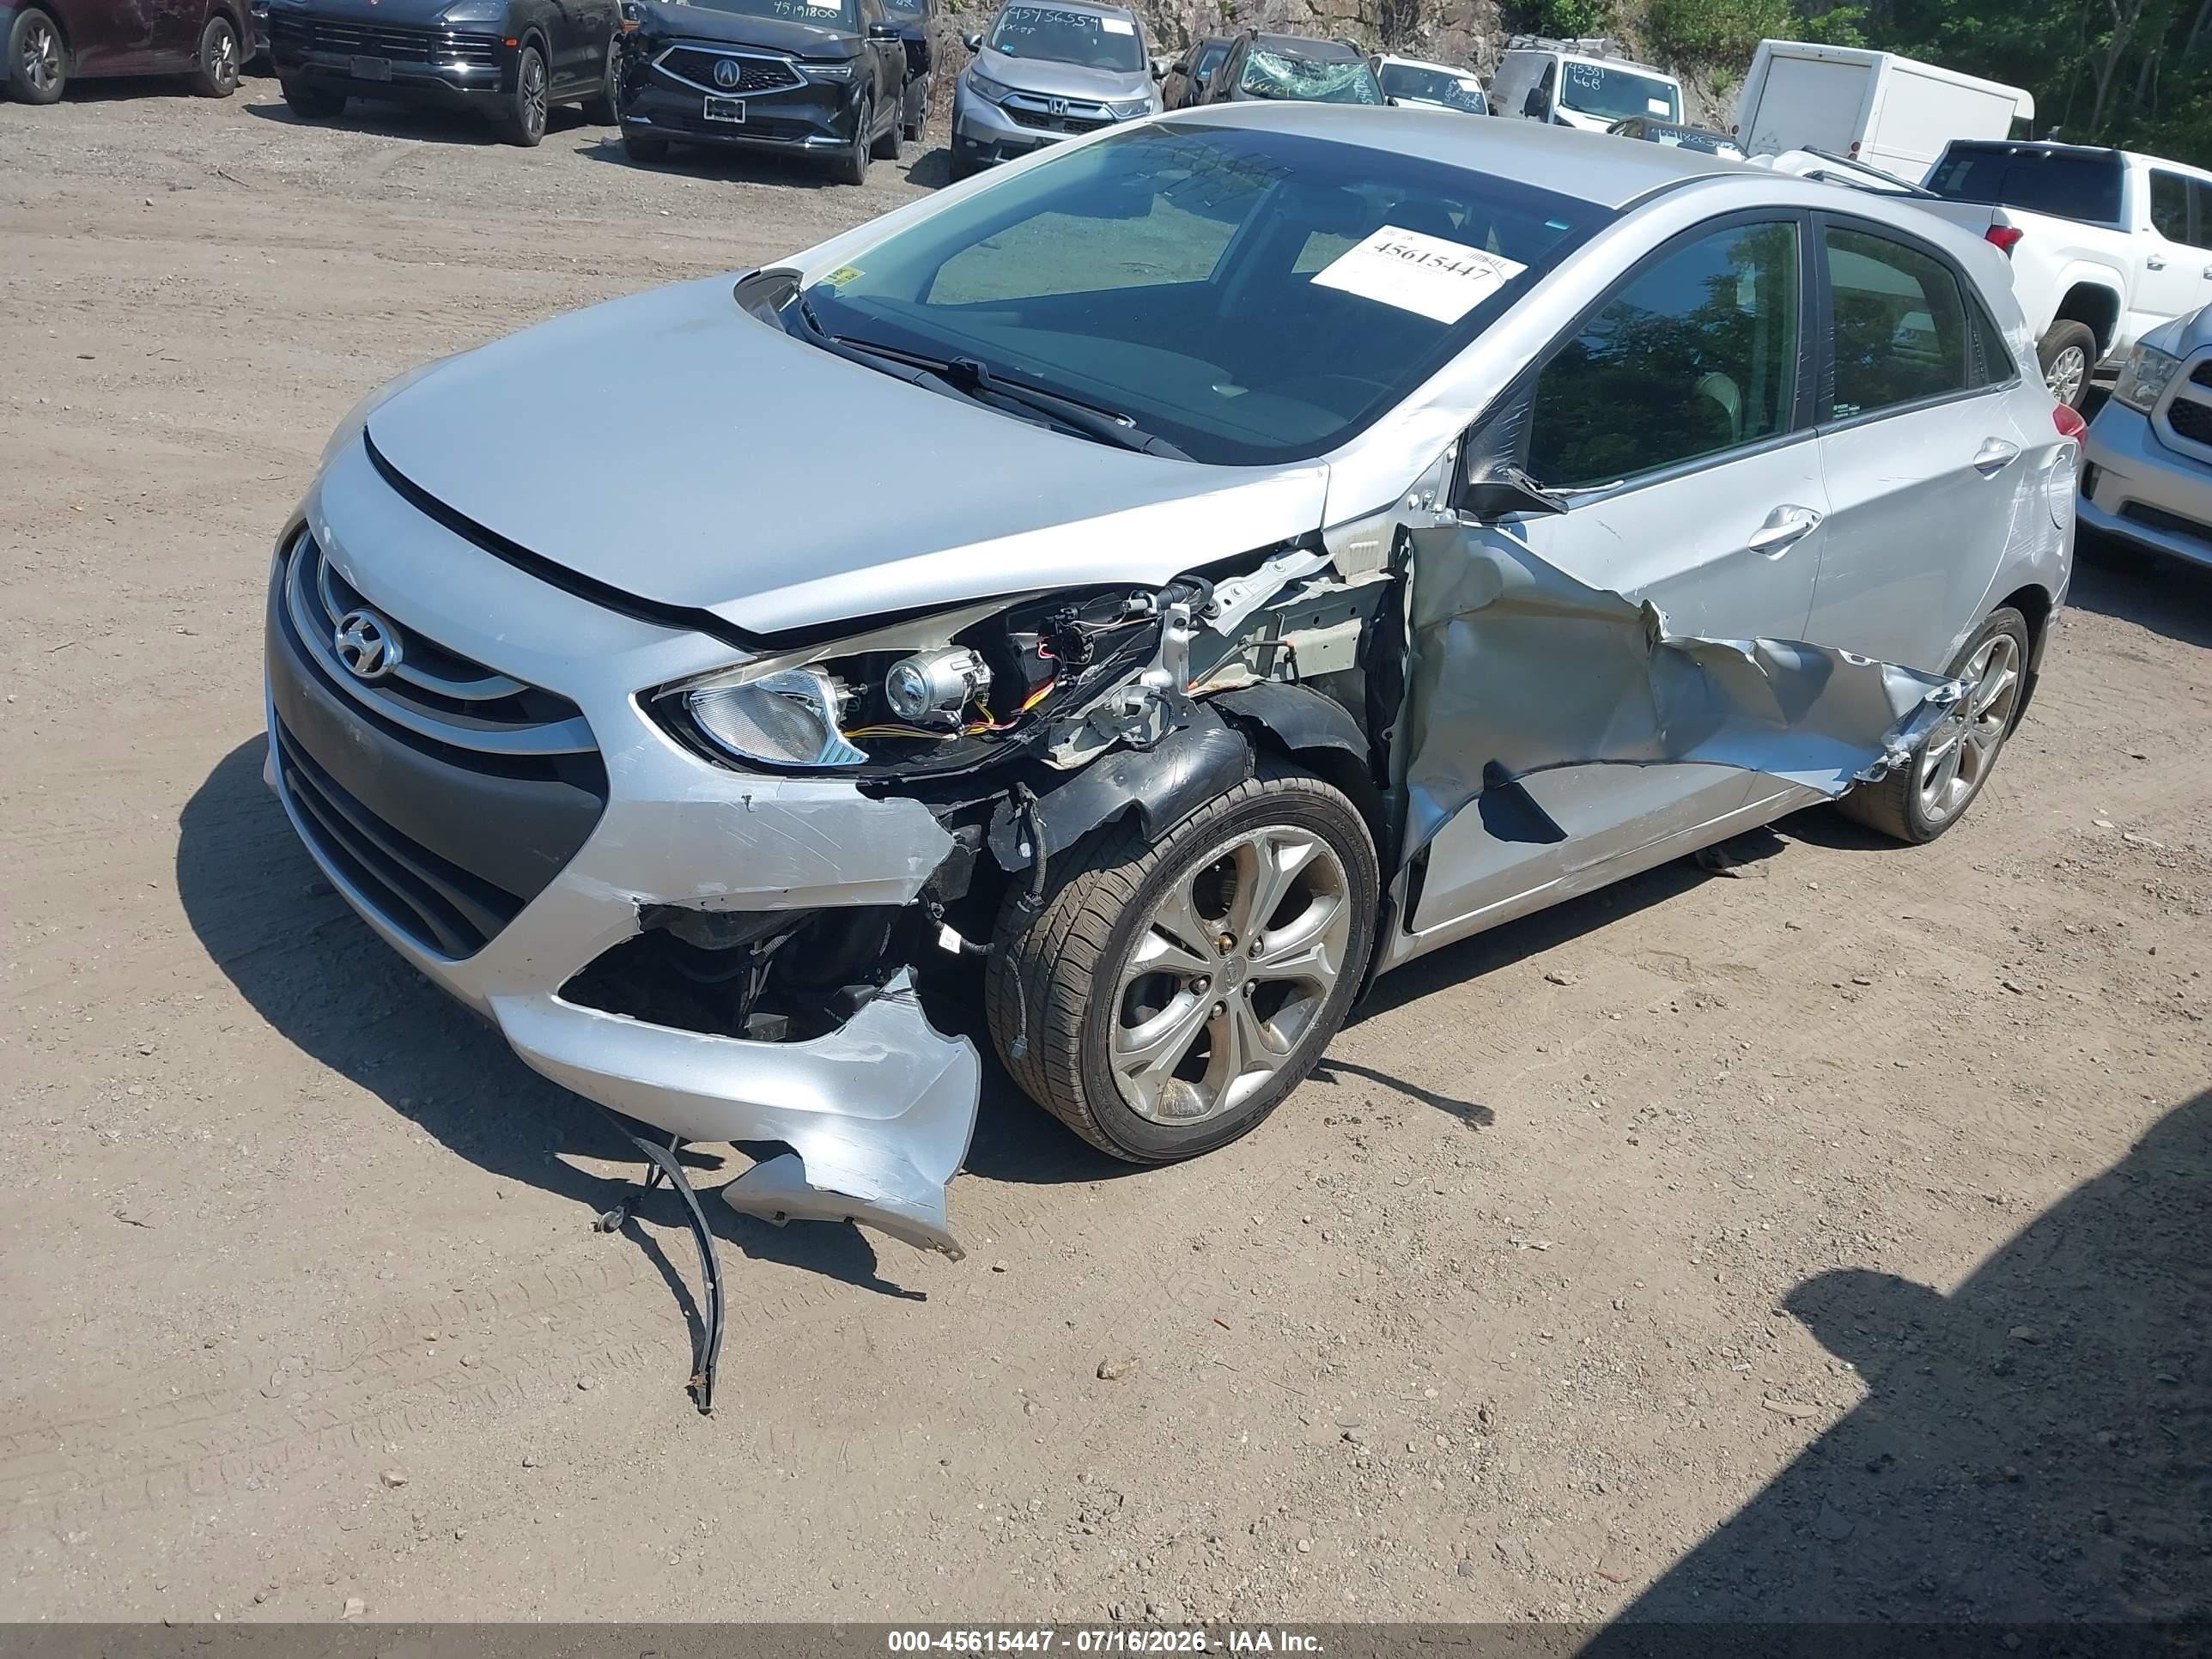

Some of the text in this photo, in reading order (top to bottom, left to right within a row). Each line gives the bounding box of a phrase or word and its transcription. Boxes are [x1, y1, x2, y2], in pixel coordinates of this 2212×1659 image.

[1568, 63, 1605, 79] 45351
[1573, 74, 1601, 90] 668
[1374, 242, 1493, 281] 45615447
